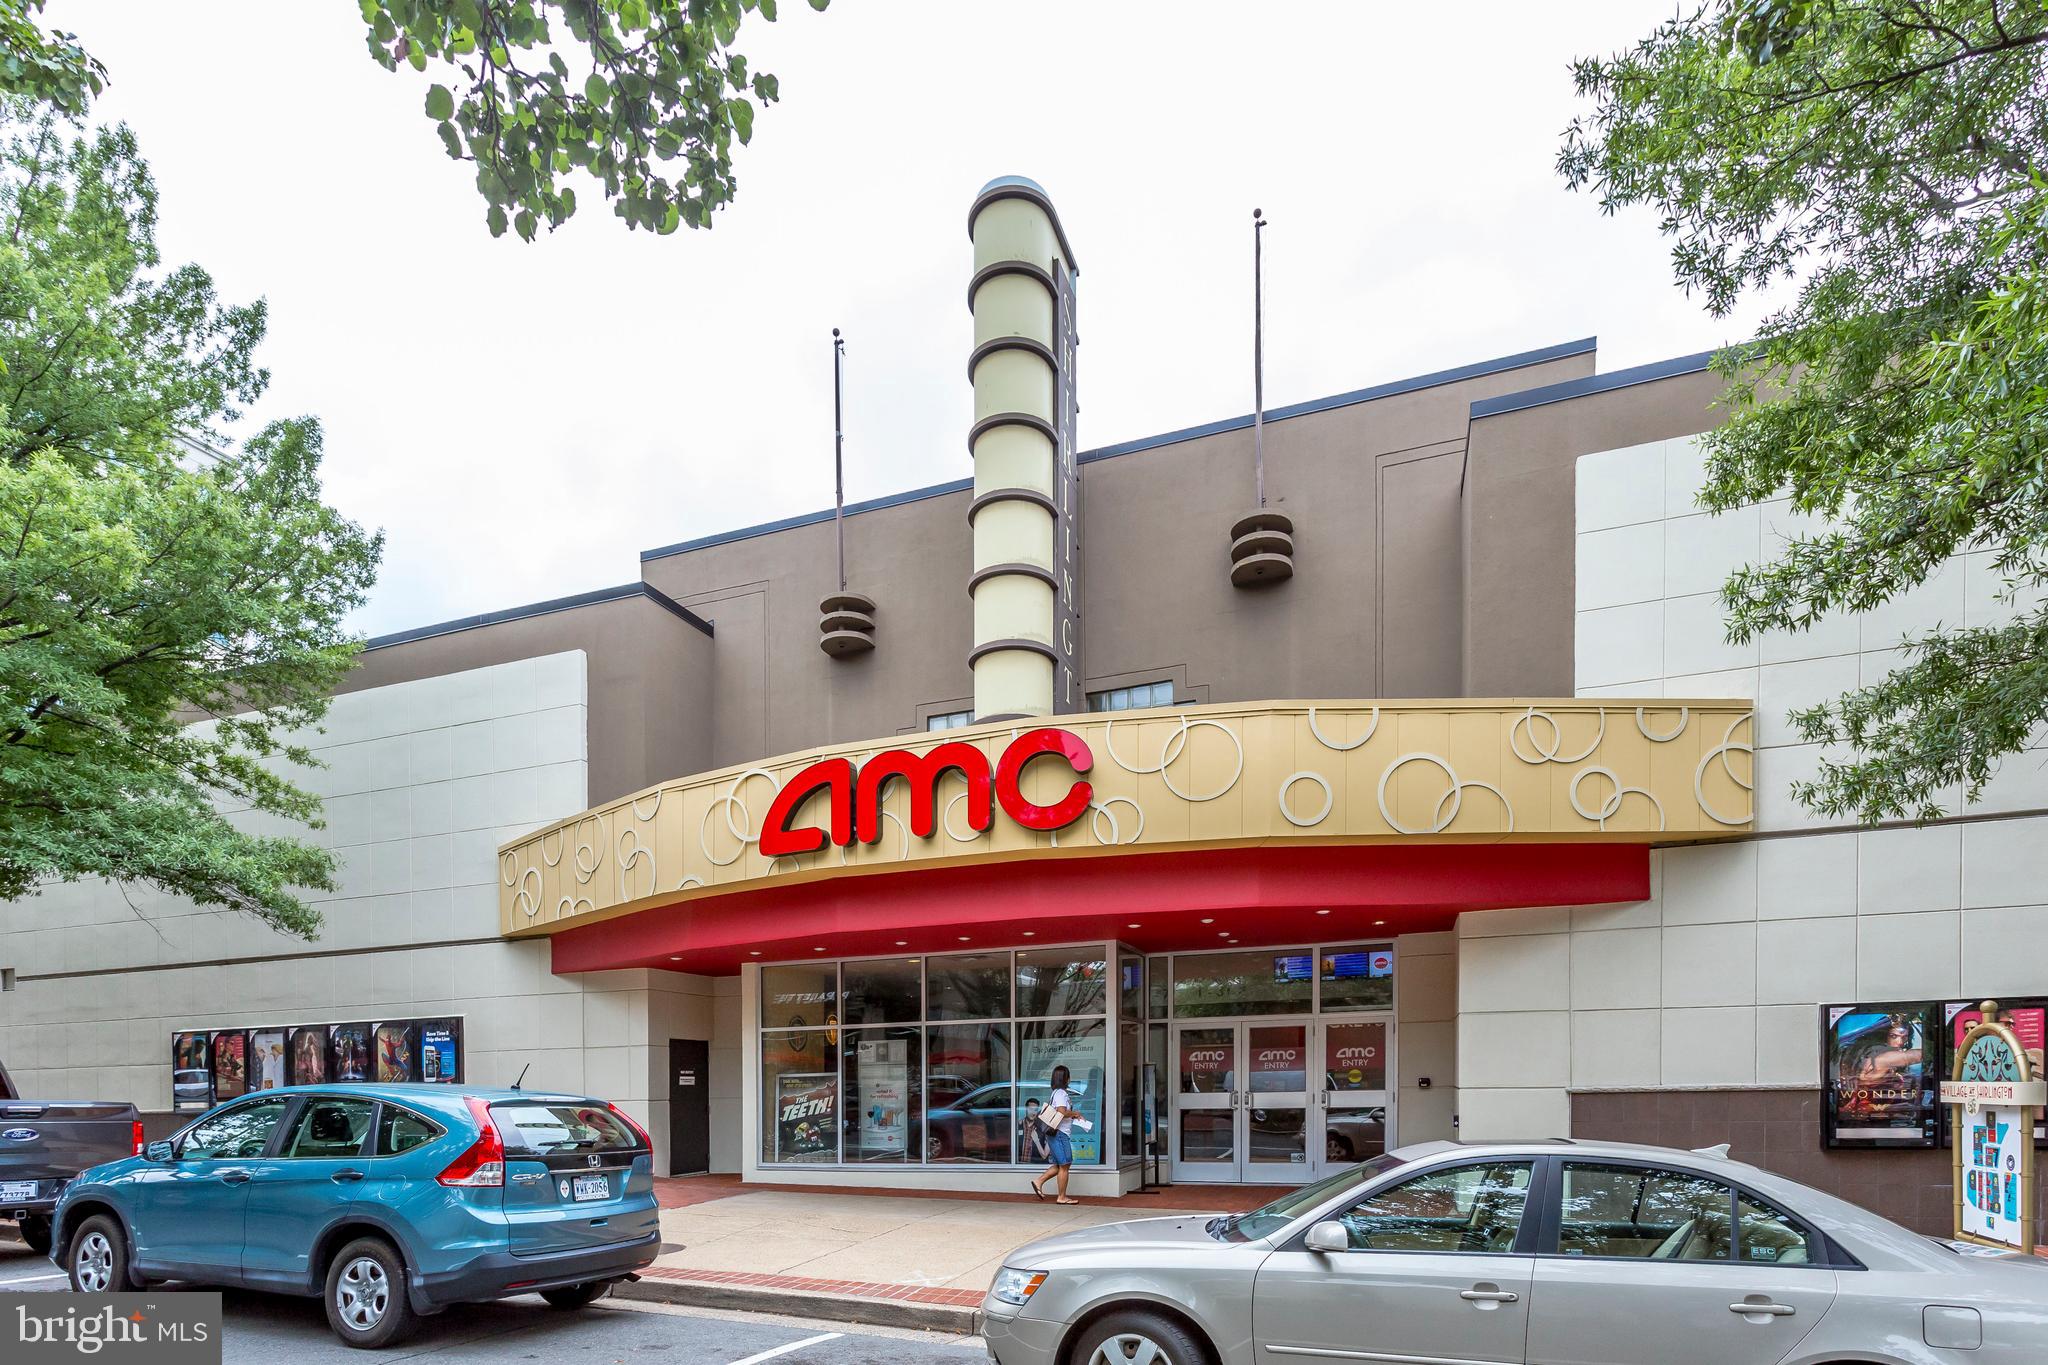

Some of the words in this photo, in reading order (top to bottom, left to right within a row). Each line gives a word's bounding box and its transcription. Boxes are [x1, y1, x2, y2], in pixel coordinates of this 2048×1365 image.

[1194, 1062, 1218, 1070] ENTRY
[1342, 1059, 1368, 1067] ENTRY
[1840, 1089, 1918, 1099] WONDER
[1945, 1085, 1968, 1098] VILLAGE
[1977, 1085, 2013, 1099] SHIRLINGTON
[795, 1095, 809, 1104] THE
[782, 1096, 834, 1121] TEETH!
[11, 1129, 32, 1138] Ford
